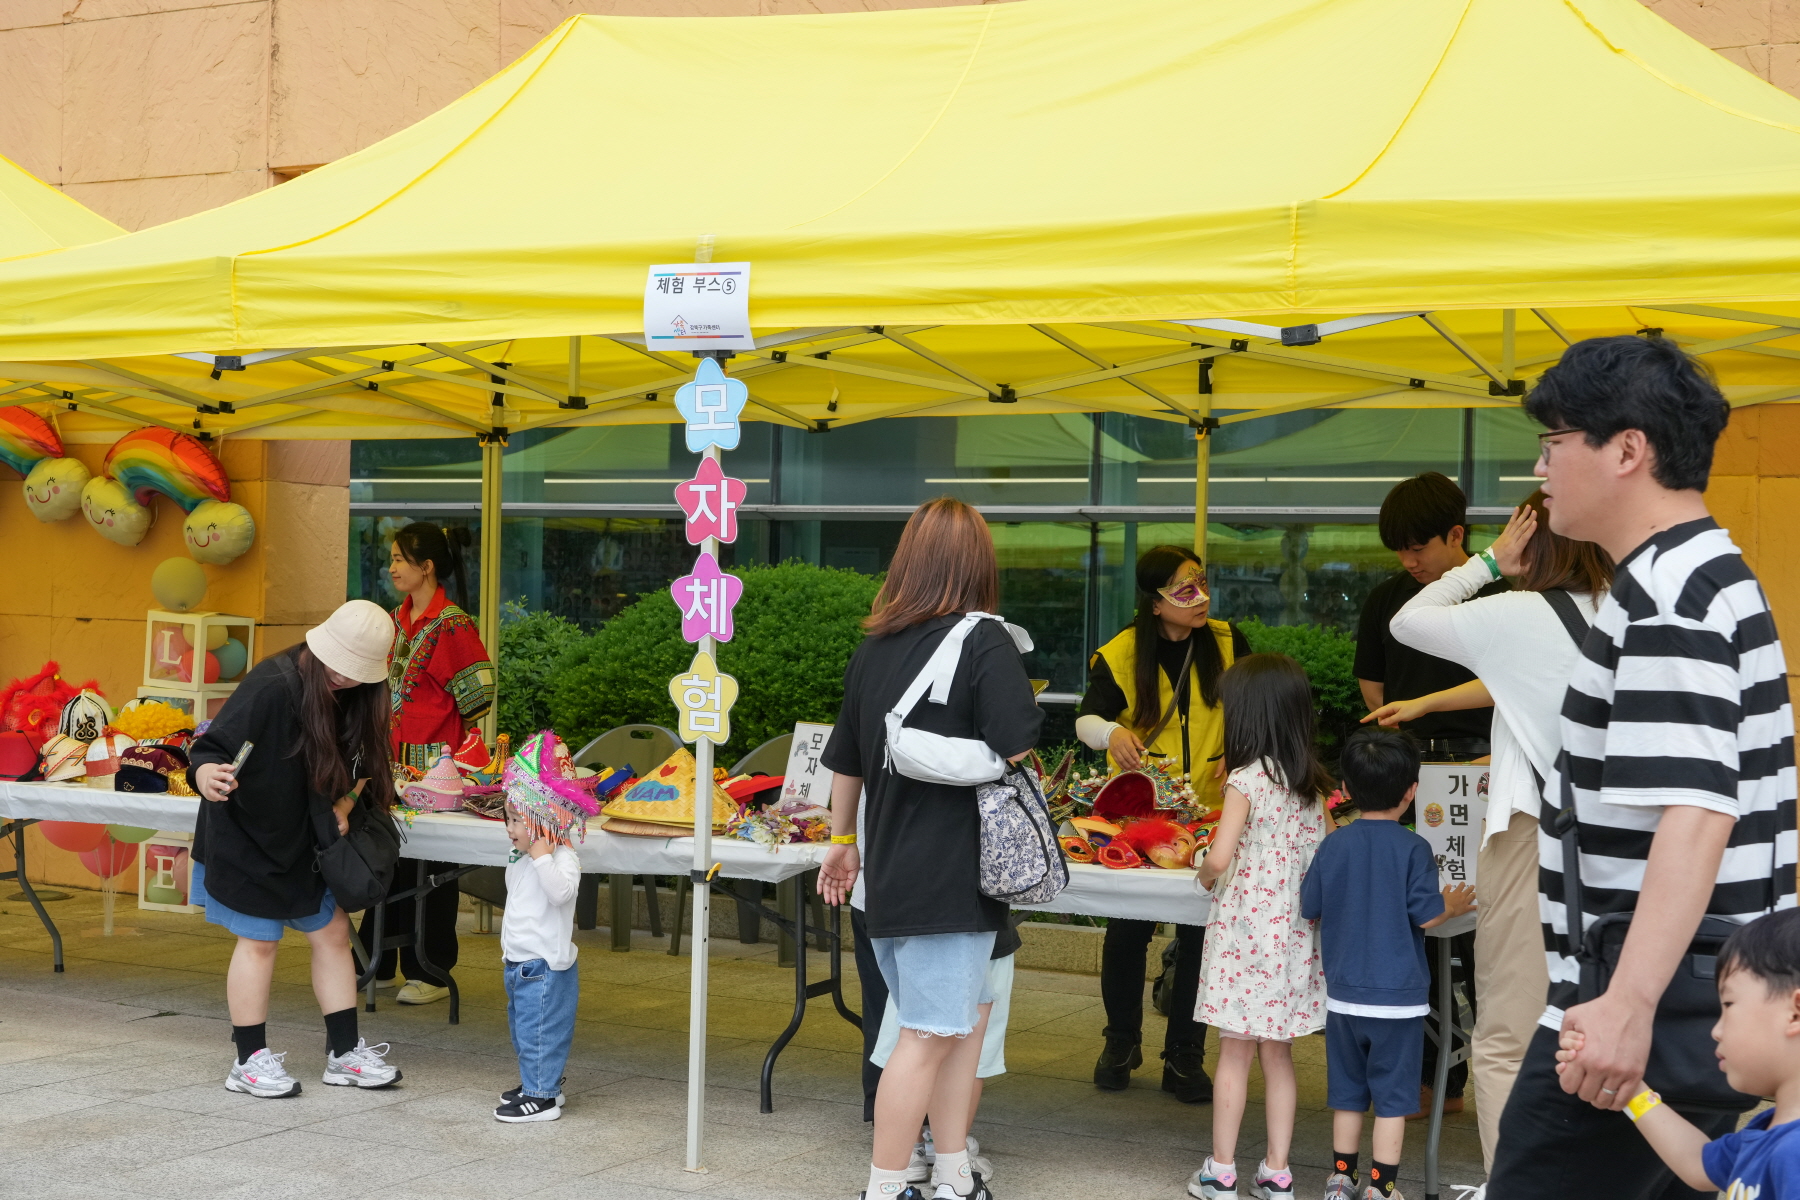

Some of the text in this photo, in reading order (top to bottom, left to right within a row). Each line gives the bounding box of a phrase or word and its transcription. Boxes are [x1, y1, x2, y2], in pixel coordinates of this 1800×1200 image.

[656, 276, 685, 294] 체험
[159, 630, 183, 665] L
[625, 786, 675, 800] NAM
[153, 855, 176, 890] E
